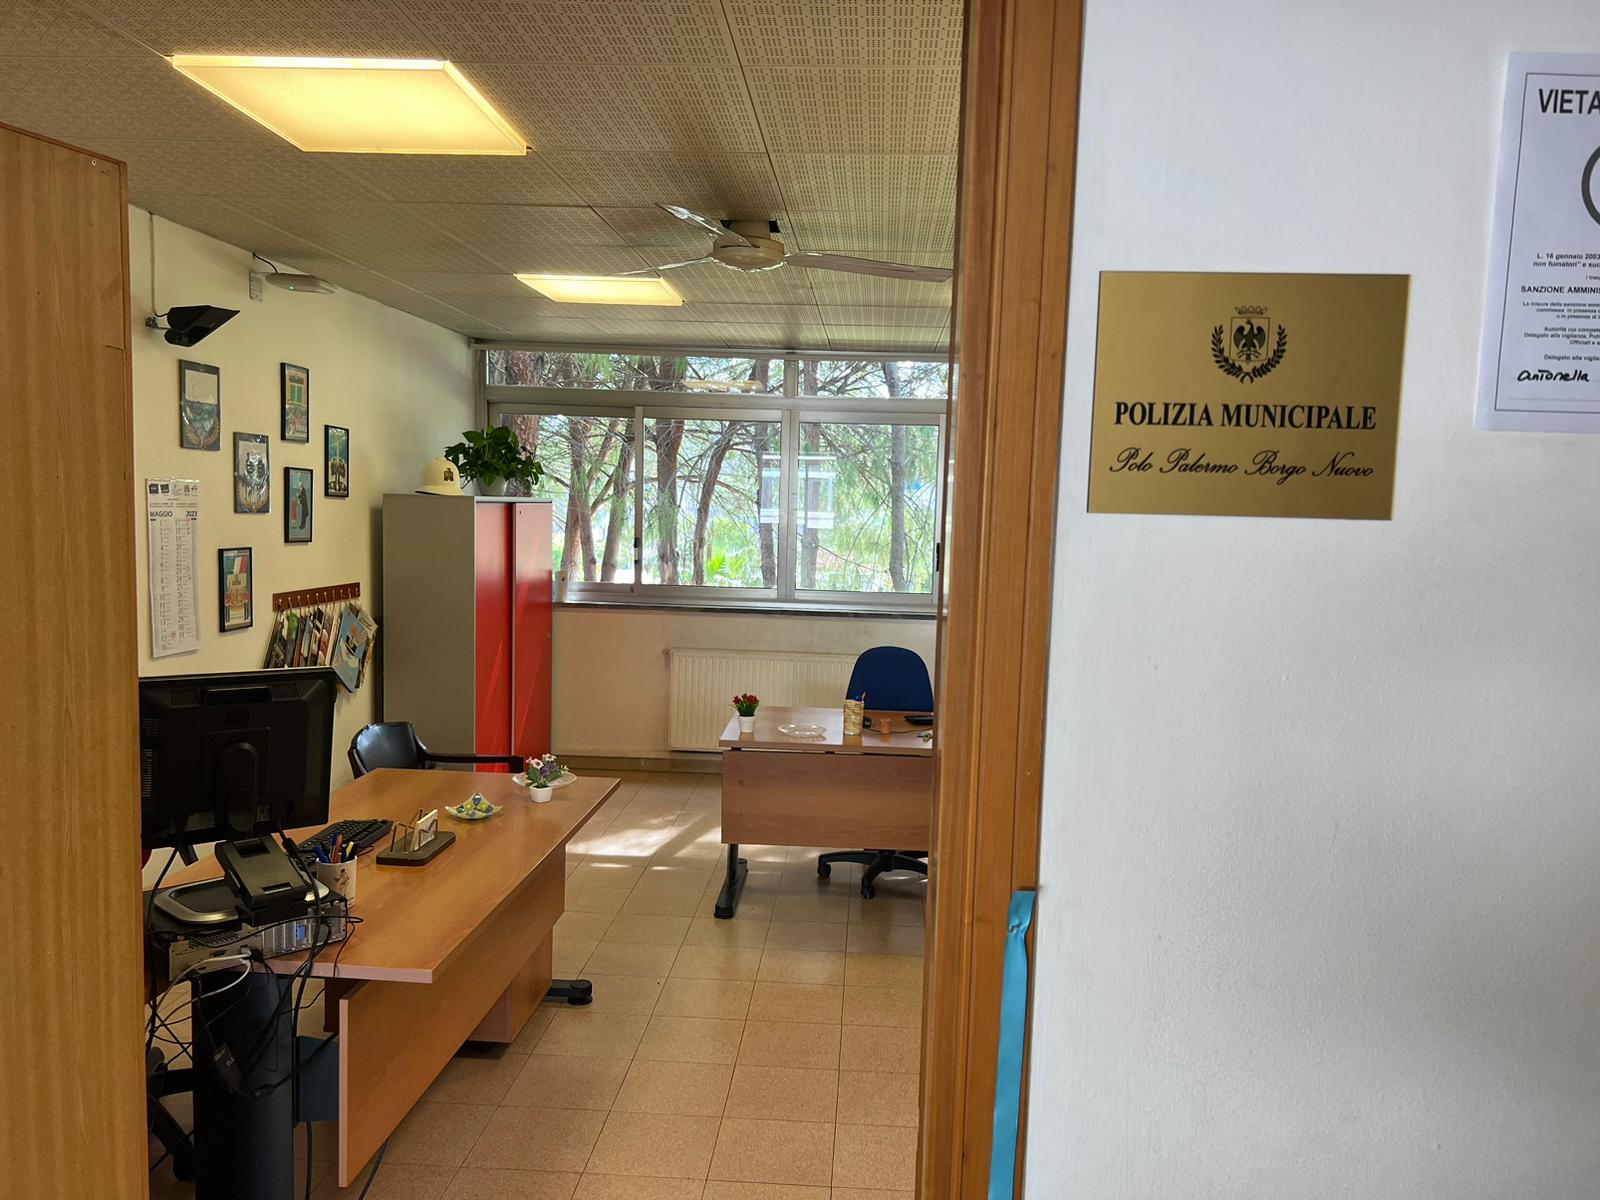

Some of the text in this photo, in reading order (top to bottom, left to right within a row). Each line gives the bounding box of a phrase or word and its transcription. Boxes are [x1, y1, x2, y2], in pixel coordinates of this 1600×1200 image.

[1521, 285, 1565, 294] SANZIONE
[1115, 402, 1377, 430] POLIZIA MUNICIPALE
[1109, 447, 1374, 486] Polo Palermo Borgo Nuovo
[149, 510, 173, 518] MAGGIO
